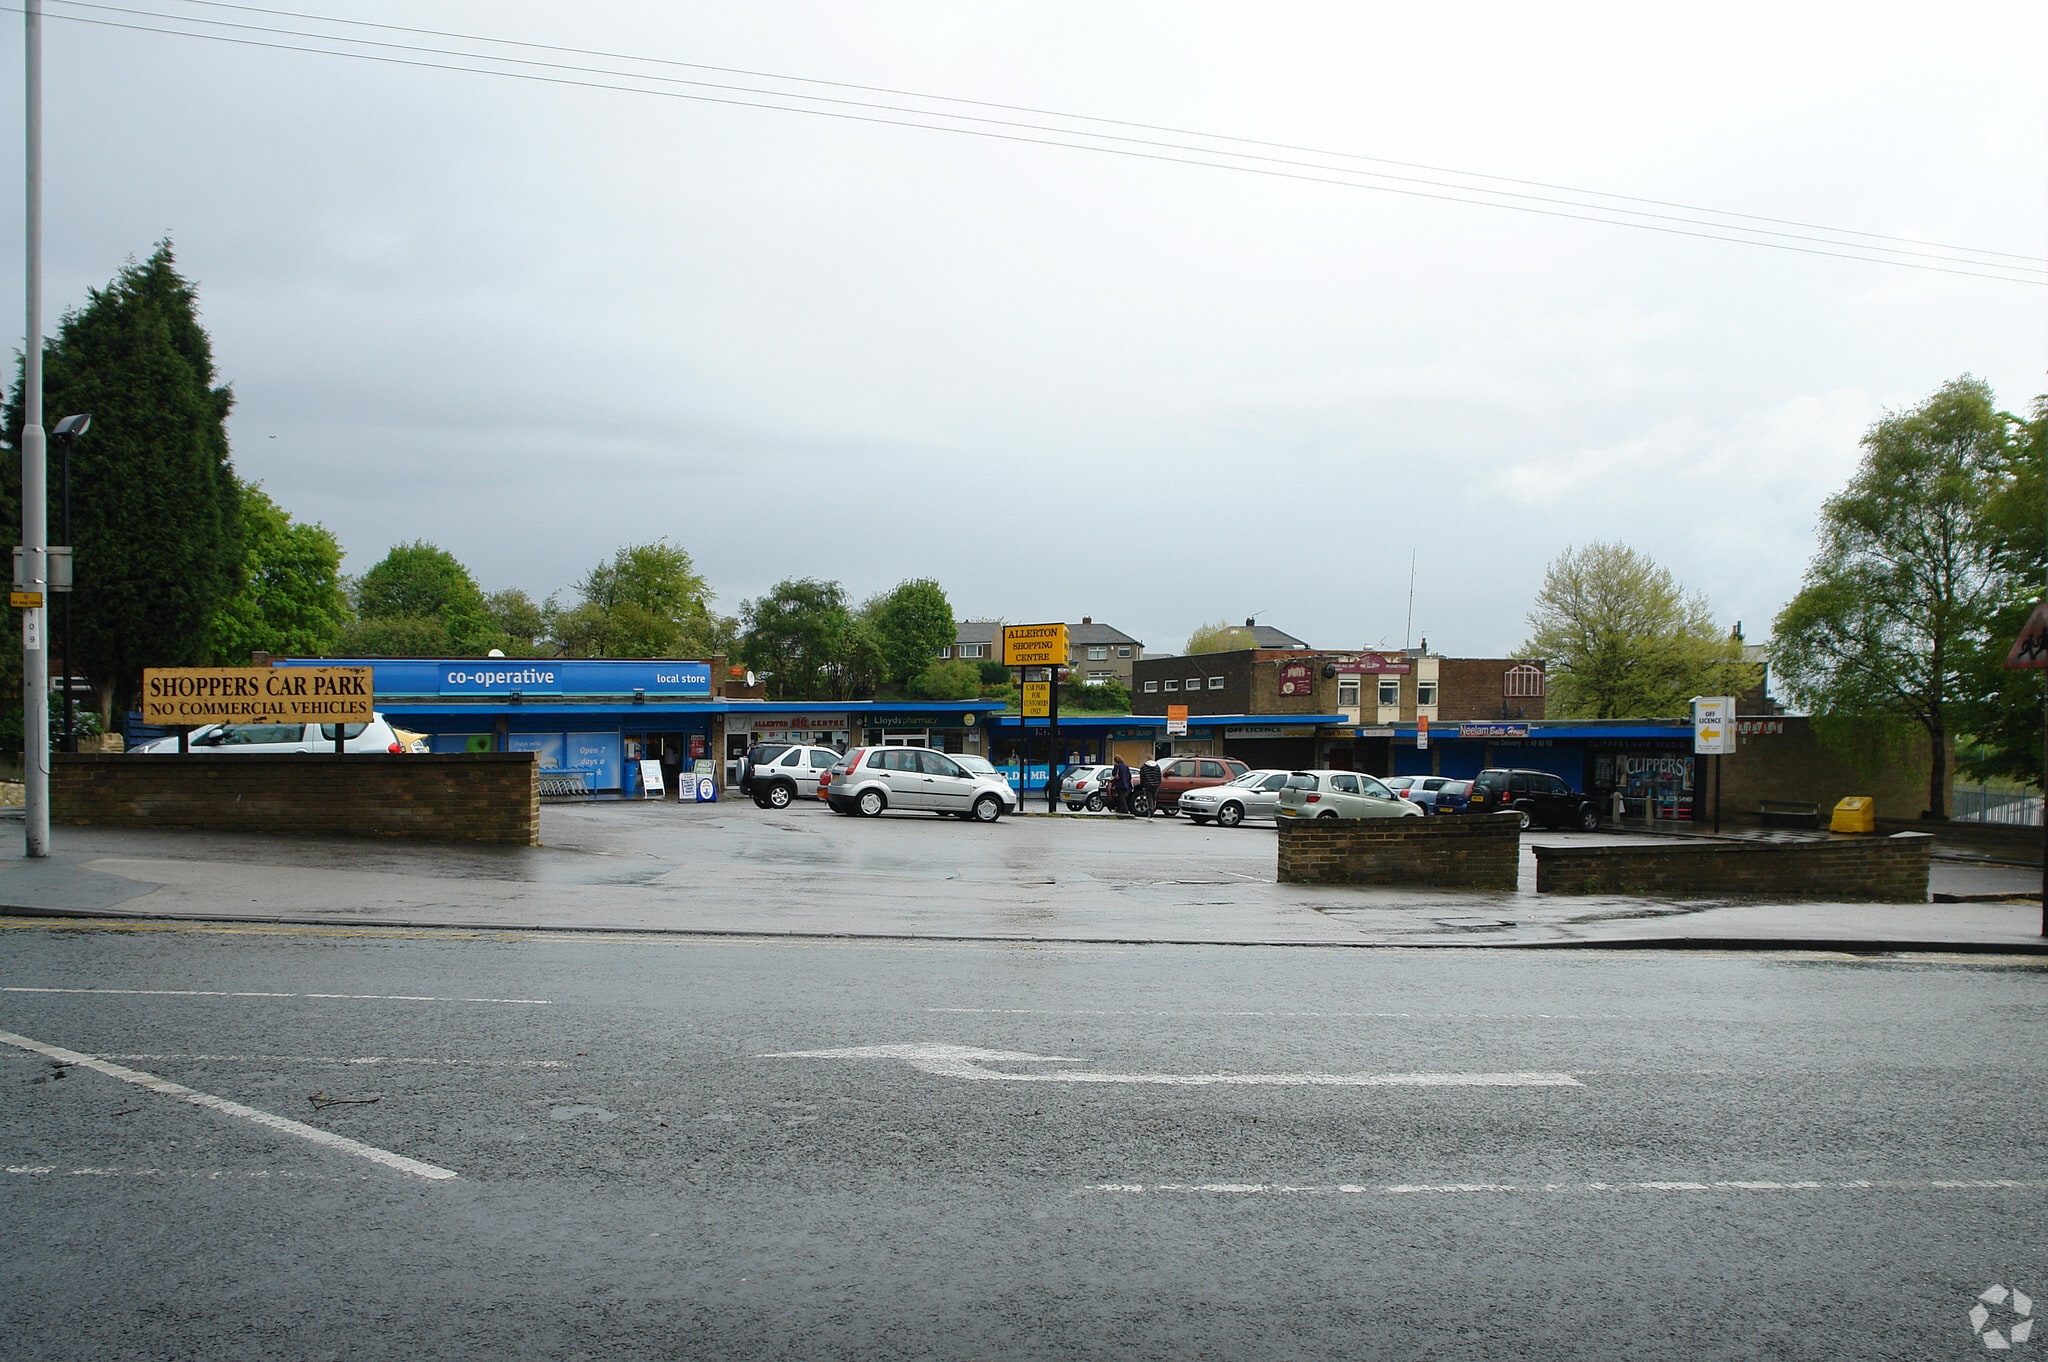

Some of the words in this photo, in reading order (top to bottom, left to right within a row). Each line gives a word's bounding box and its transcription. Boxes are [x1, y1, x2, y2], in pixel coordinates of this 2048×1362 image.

[1008, 628, 1058, 639] ALLERTON
[1012, 641, 1053, 650] SHOPPING
[1015, 653, 1050, 662] CENTRE
[447, 668, 555, 687] co-operative
[657, 673, 680, 684] local
[681, 674, 706, 684] store
[150, 676, 259, 697] SHOPPERS
[266, 676, 308, 696] CAR
[313, 676, 367, 696] PARK
[150, 702, 174, 716] NO
[180, 701, 286, 716] COMMERCIAL
[291, 700, 368, 714] VEHICLES
[754, 720, 788, 728] ALLERTON
[1460, 725, 1489, 735] Neelam
[580, 746, 598, 755] Open
[580, 758, 598, 766] days
[1627, 757, 1684, 776] CLIPPERS
